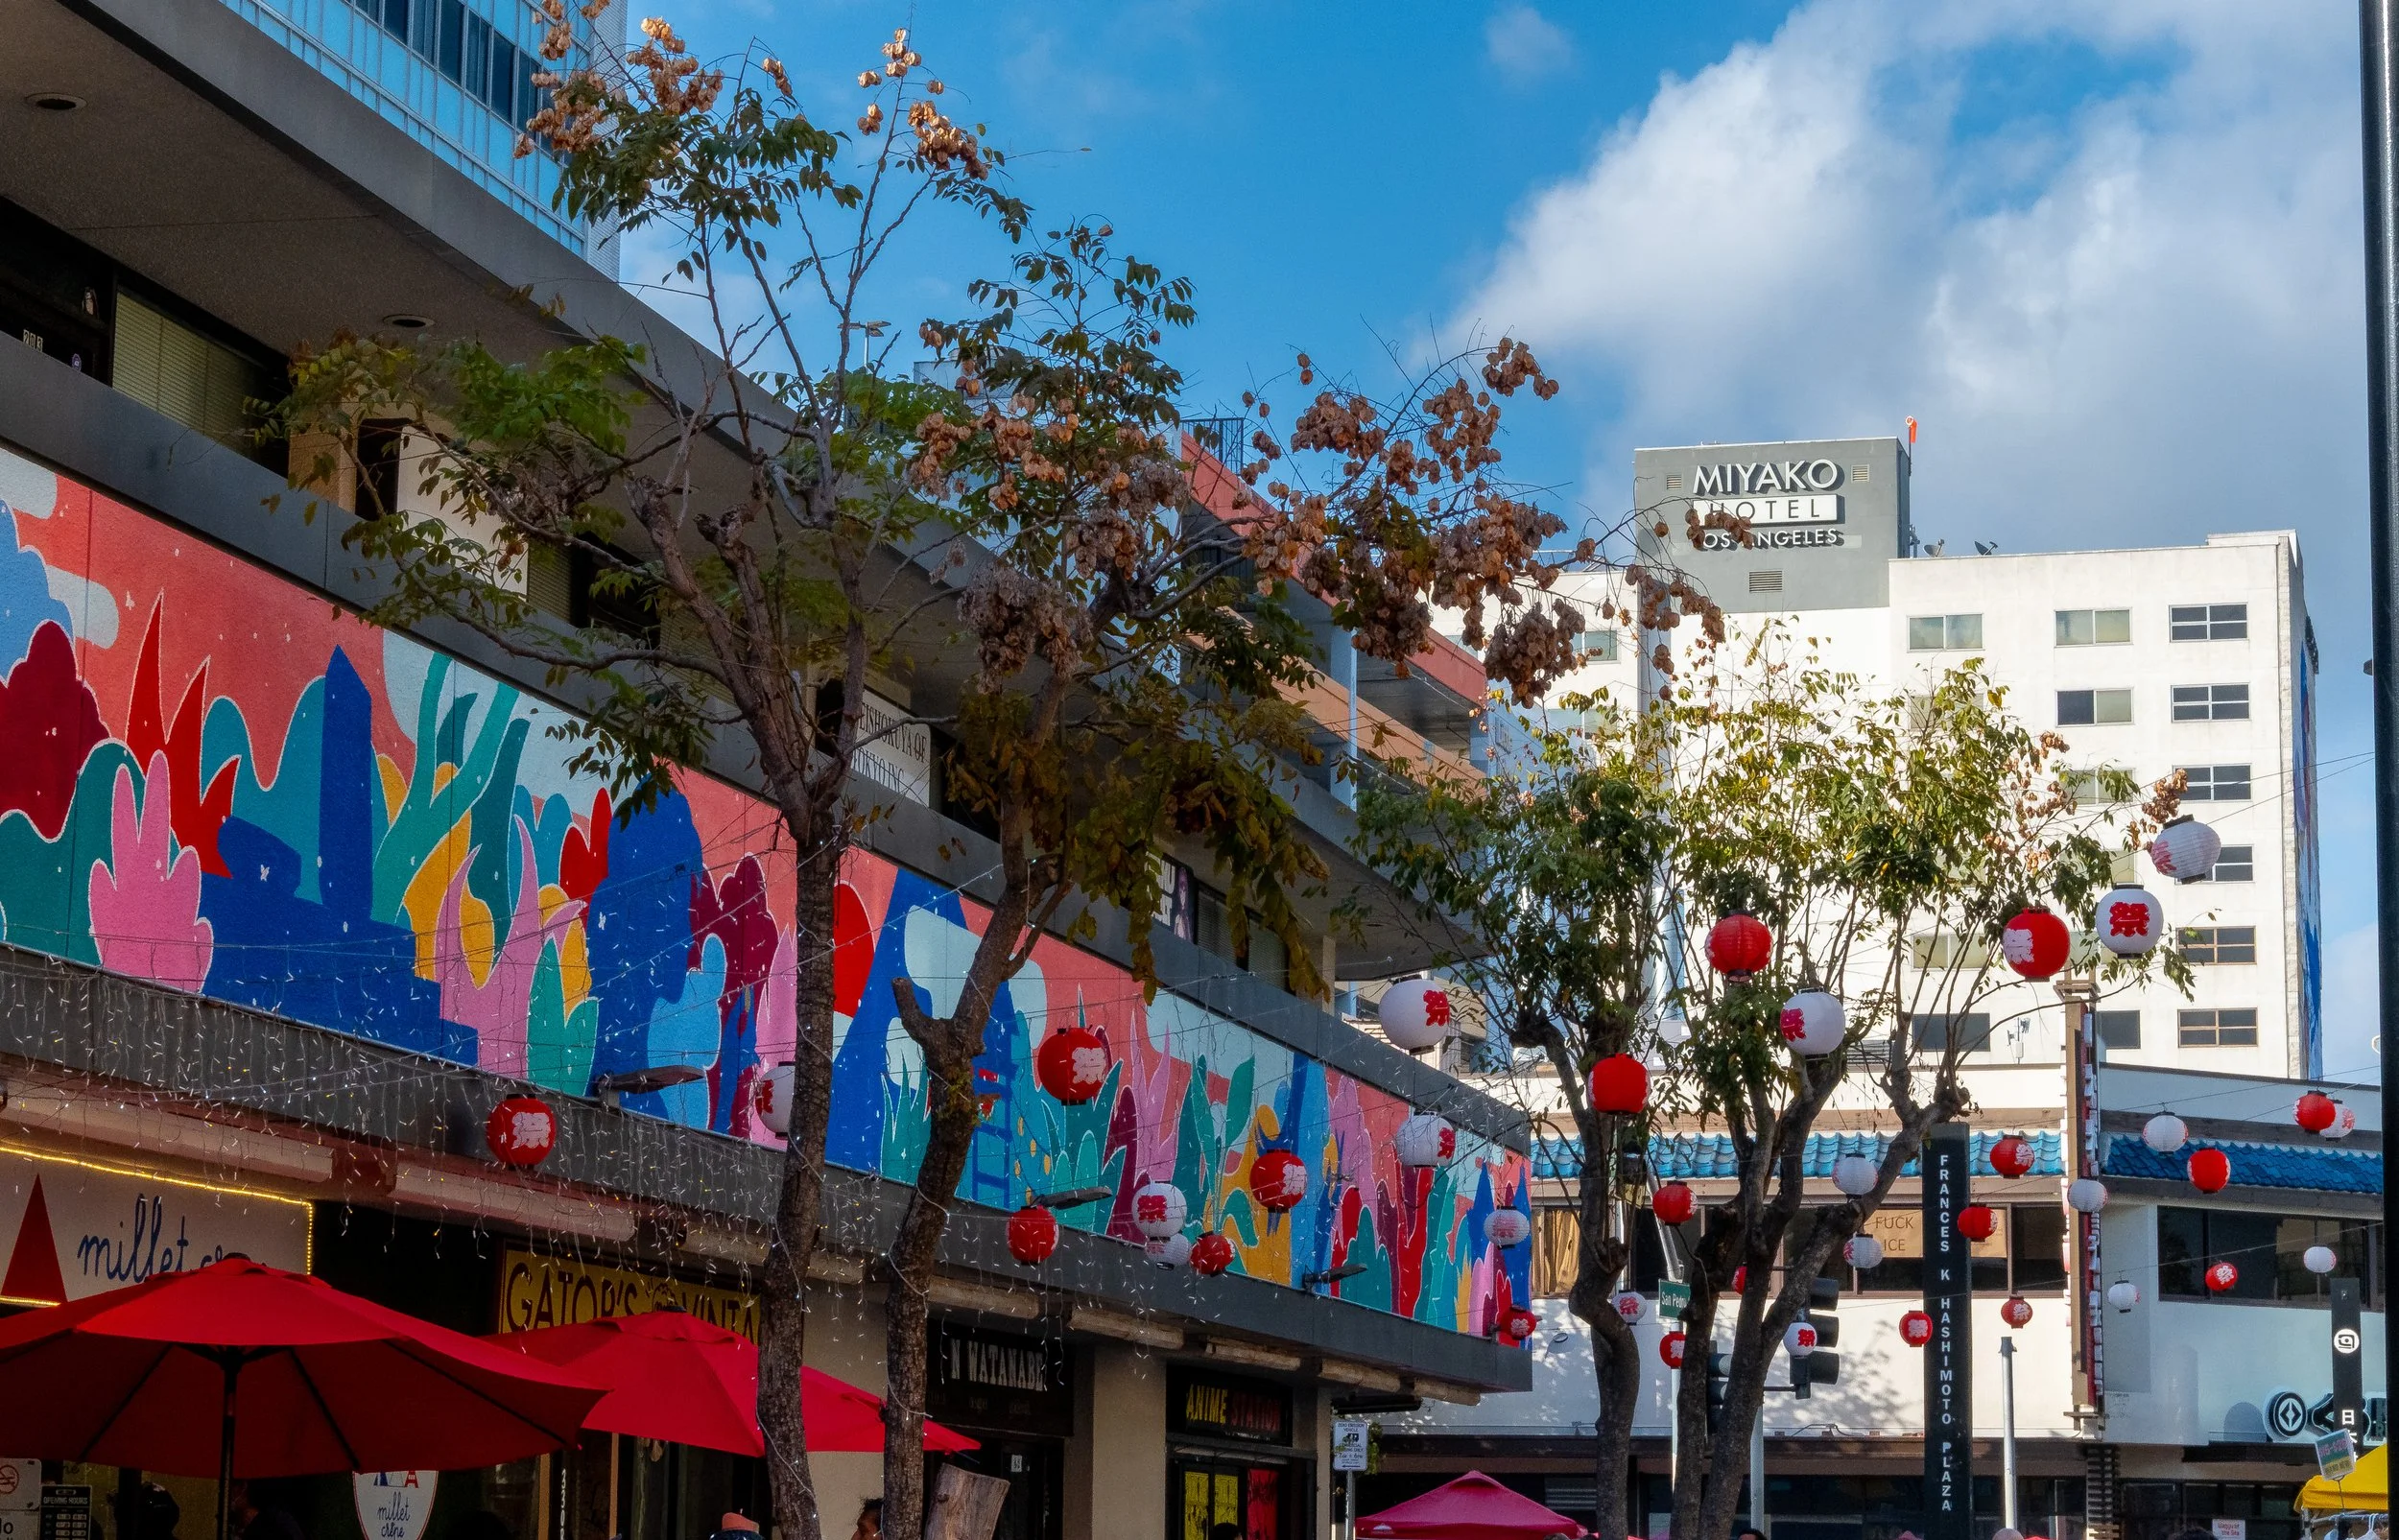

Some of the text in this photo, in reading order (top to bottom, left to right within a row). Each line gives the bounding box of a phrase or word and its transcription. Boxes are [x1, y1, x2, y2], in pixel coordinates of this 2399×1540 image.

[1693, 459, 1838, 493] MIYAKO
[1703, 528, 1838, 548] OS NGELES
[914, 732, 927, 764] OF
[77, 1193, 189, 1284] millet
[1876, 1217, 1913, 1229] FUCK
[1884, 1239, 1906, 1251] ICE
[1661, 1291, 1688, 1308] San Pedro
[681, 1291, 755, 1345] VINTA
[1939, 1154, 1953, 1511] FRANCES K HASHIMOTO PLAZA
[967, 1339, 1044, 1391] WATANABE
[1185, 1383, 1282, 1433] ANIME STATION
[43, 1496, 88, 1505] OPENING HOURS
[377, 1491, 411, 1522] millet
